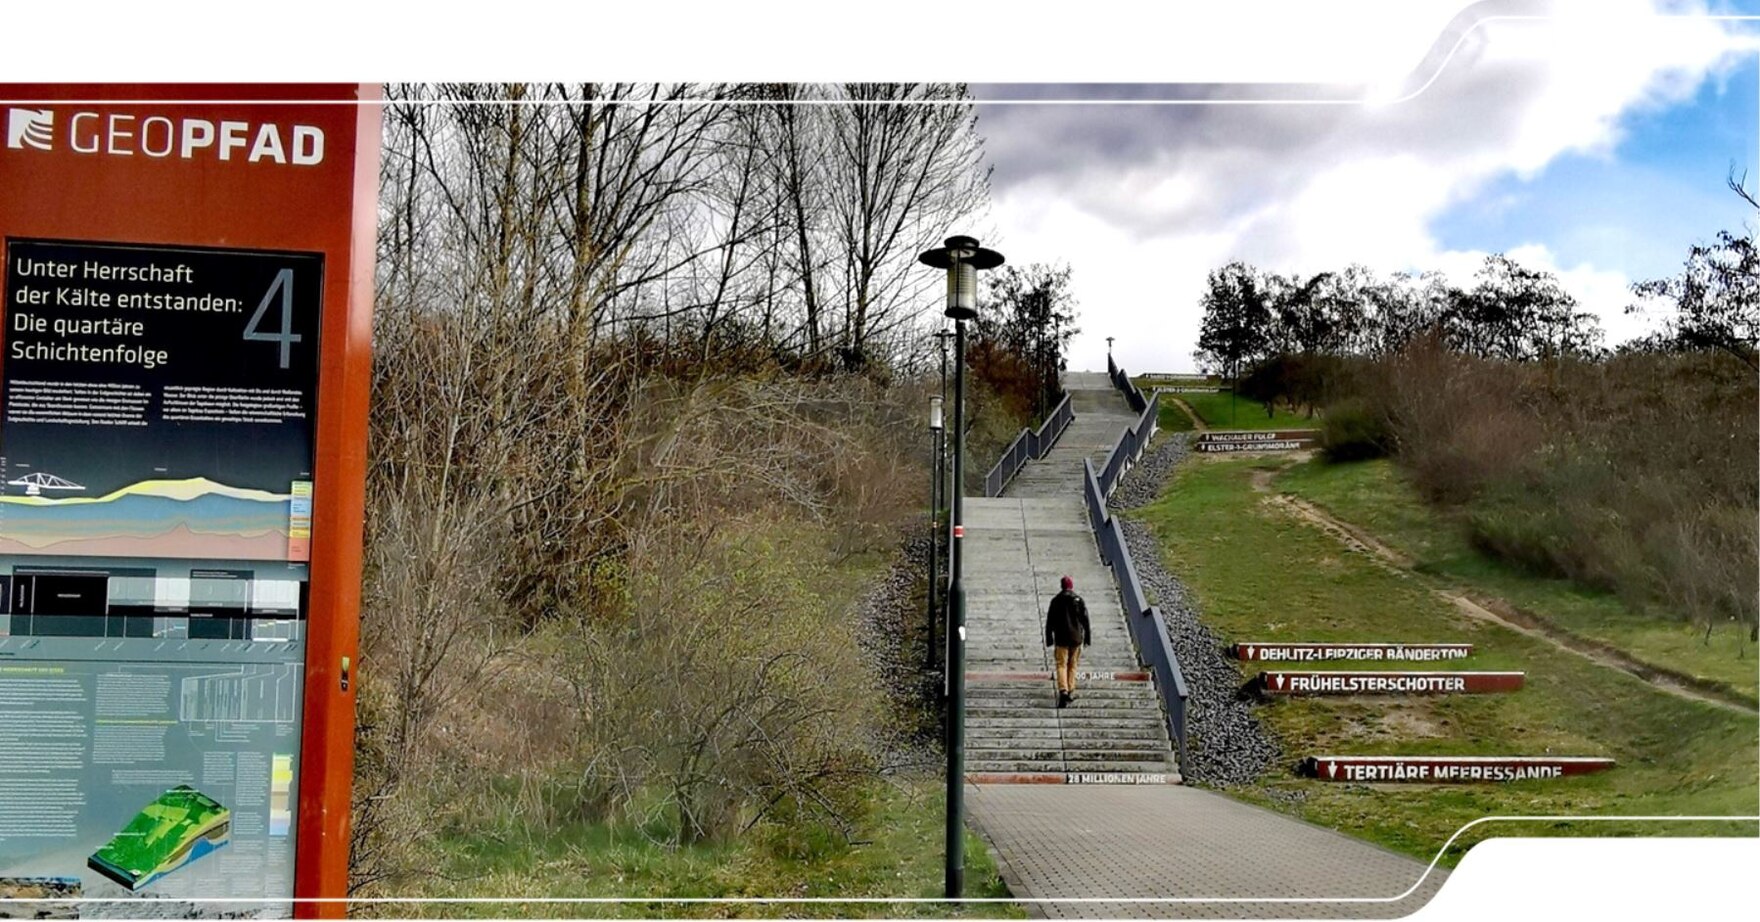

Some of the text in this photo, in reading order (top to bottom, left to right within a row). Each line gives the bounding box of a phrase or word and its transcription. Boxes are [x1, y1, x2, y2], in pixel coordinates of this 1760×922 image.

[70, 111, 325, 166] GEOPFAD
[17, 258, 194, 284] Unter Herrschaft
[15, 286, 243, 313] der Kälte entstanden:
[14, 314, 144, 338] Die quartäre
[242, 267, 302, 370] 4
[11, 341, 169, 369] Schichtenfolge
[1290, 674, 1466, 692] FRÜHELSTERSCHOTTER
[1068, 773, 1167, 785] 28 MILLIONEN JAHRE
[1343, 762, 1563, 781] TERTIÄRE MEERESSANDE
